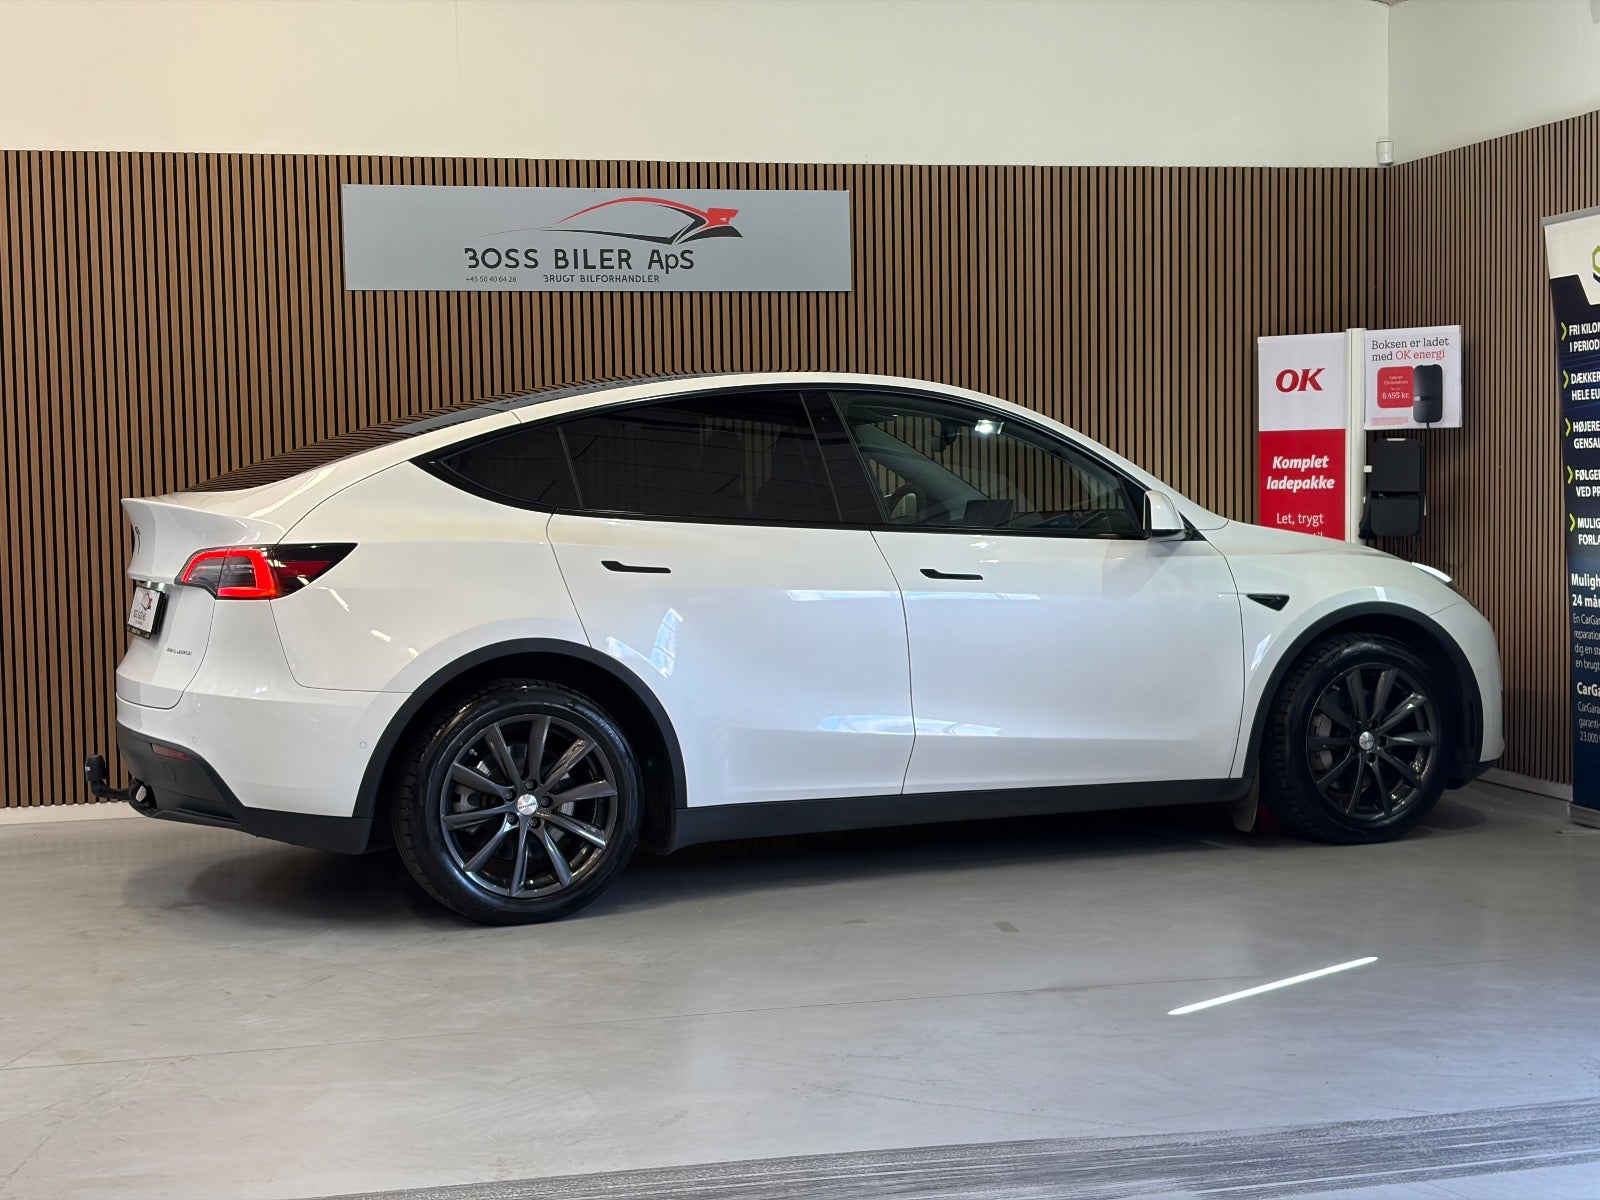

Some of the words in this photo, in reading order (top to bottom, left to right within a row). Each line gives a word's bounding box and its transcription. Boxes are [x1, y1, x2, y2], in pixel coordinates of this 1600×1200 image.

[464, 248, 539, 269] BOSS
[554, 248, 632, 269] BILER
[647, 249, 695, 274] ApS
[479, 275, 488, 283] 50
[489, 275, 498, 283] 40
[543, 274, 575, 283] BRUGT
[580, 274, 660, 283] BILFORHANDLER
[1569, 324, 1580, 336] FRI
[1371, 340, 1407, 350] Boksen
[1409, 340, 1421, 348] er
[1423, 337, 1450, 347] ladet
[1569, 341, 1573, 353] I
[1371, 351, 1393, 361] med
[1395, 350, 1411, 360] OK
[1413, 348, 1445, 361] energi
[1275, 367, 1326, 393] OK
[1571, 389, 1590, 401] HELE
[1572, 420, 1600, 433] HØJERE
[1272, 454, 1330, 472] Komplet
[1266, 475, 1336, 493] ladepakke
[1575, 485, 1591, 497] VED
[1276, 512, 1295, 526] Let,
[1298, 513, 1324, 527] trygt
[1572, 593, 1583, 607] 24
